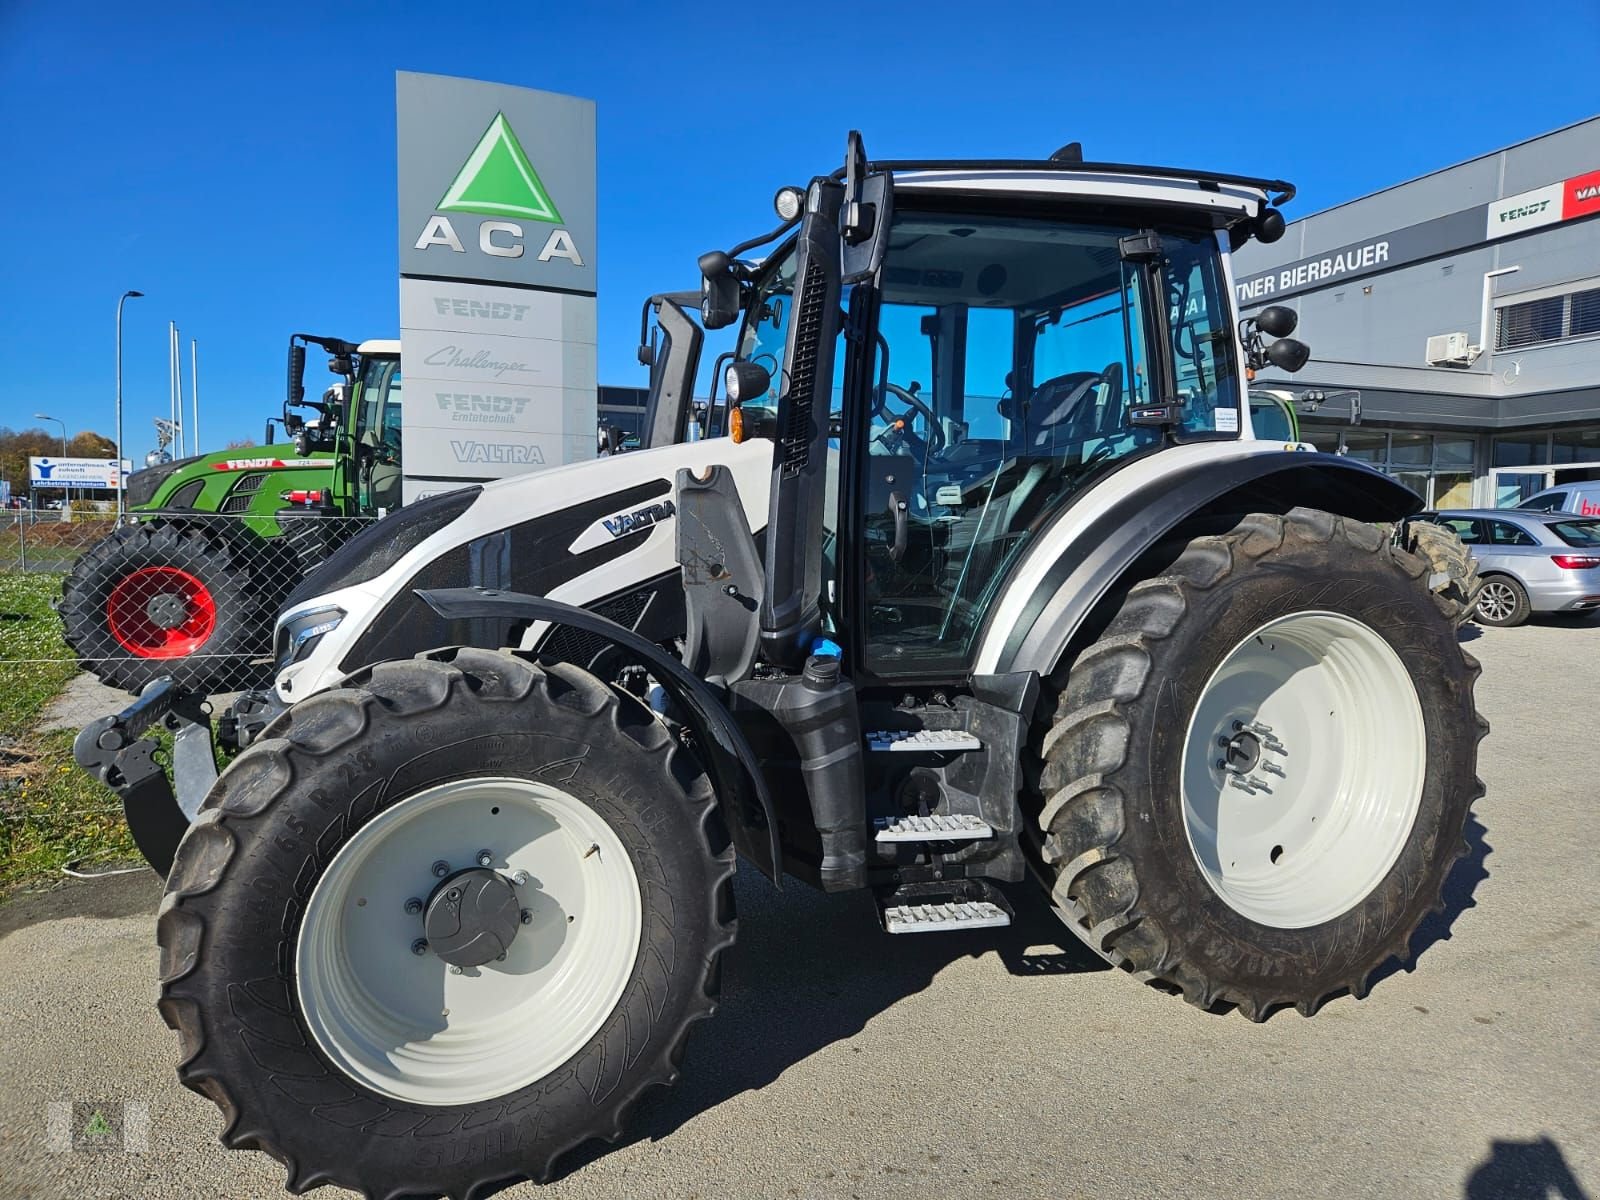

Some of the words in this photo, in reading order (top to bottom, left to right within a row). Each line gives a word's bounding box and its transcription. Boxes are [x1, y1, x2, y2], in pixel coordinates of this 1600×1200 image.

[1499, 199, 1551, 222] FENDT
[413, 214, 586, 267] ACA
[1279, 241, 1390, 291] BIERBAUER
[433, 297, 531, 321] FENDT
[423, 345, 542, 377] Challenger
[435, 393, 532, 414] FENDT
[226, 458, 277, 470] FENDT
[450, 440, 546, 465] VALTRA
[602, 499, 676, 538] VALTRA
